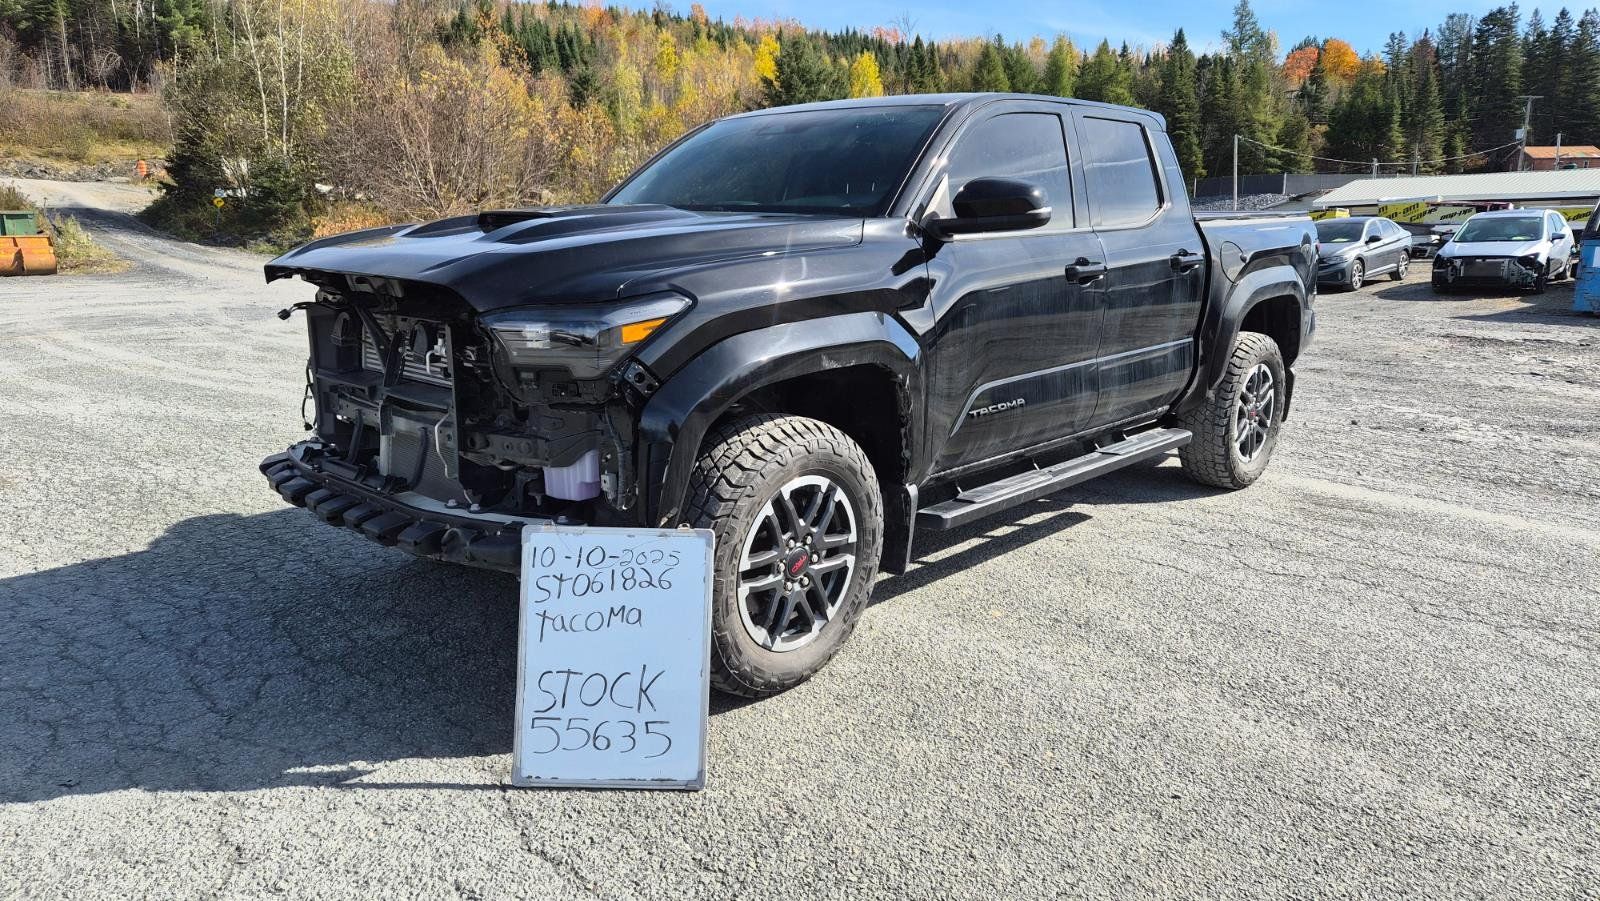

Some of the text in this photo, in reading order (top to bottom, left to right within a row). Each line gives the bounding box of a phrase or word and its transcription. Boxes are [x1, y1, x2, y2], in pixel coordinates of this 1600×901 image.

[969, 398, 1026, 417] TACOMA
[534, 664, 665, 713] STOCK
[531, 716, 672, 759] 55635
